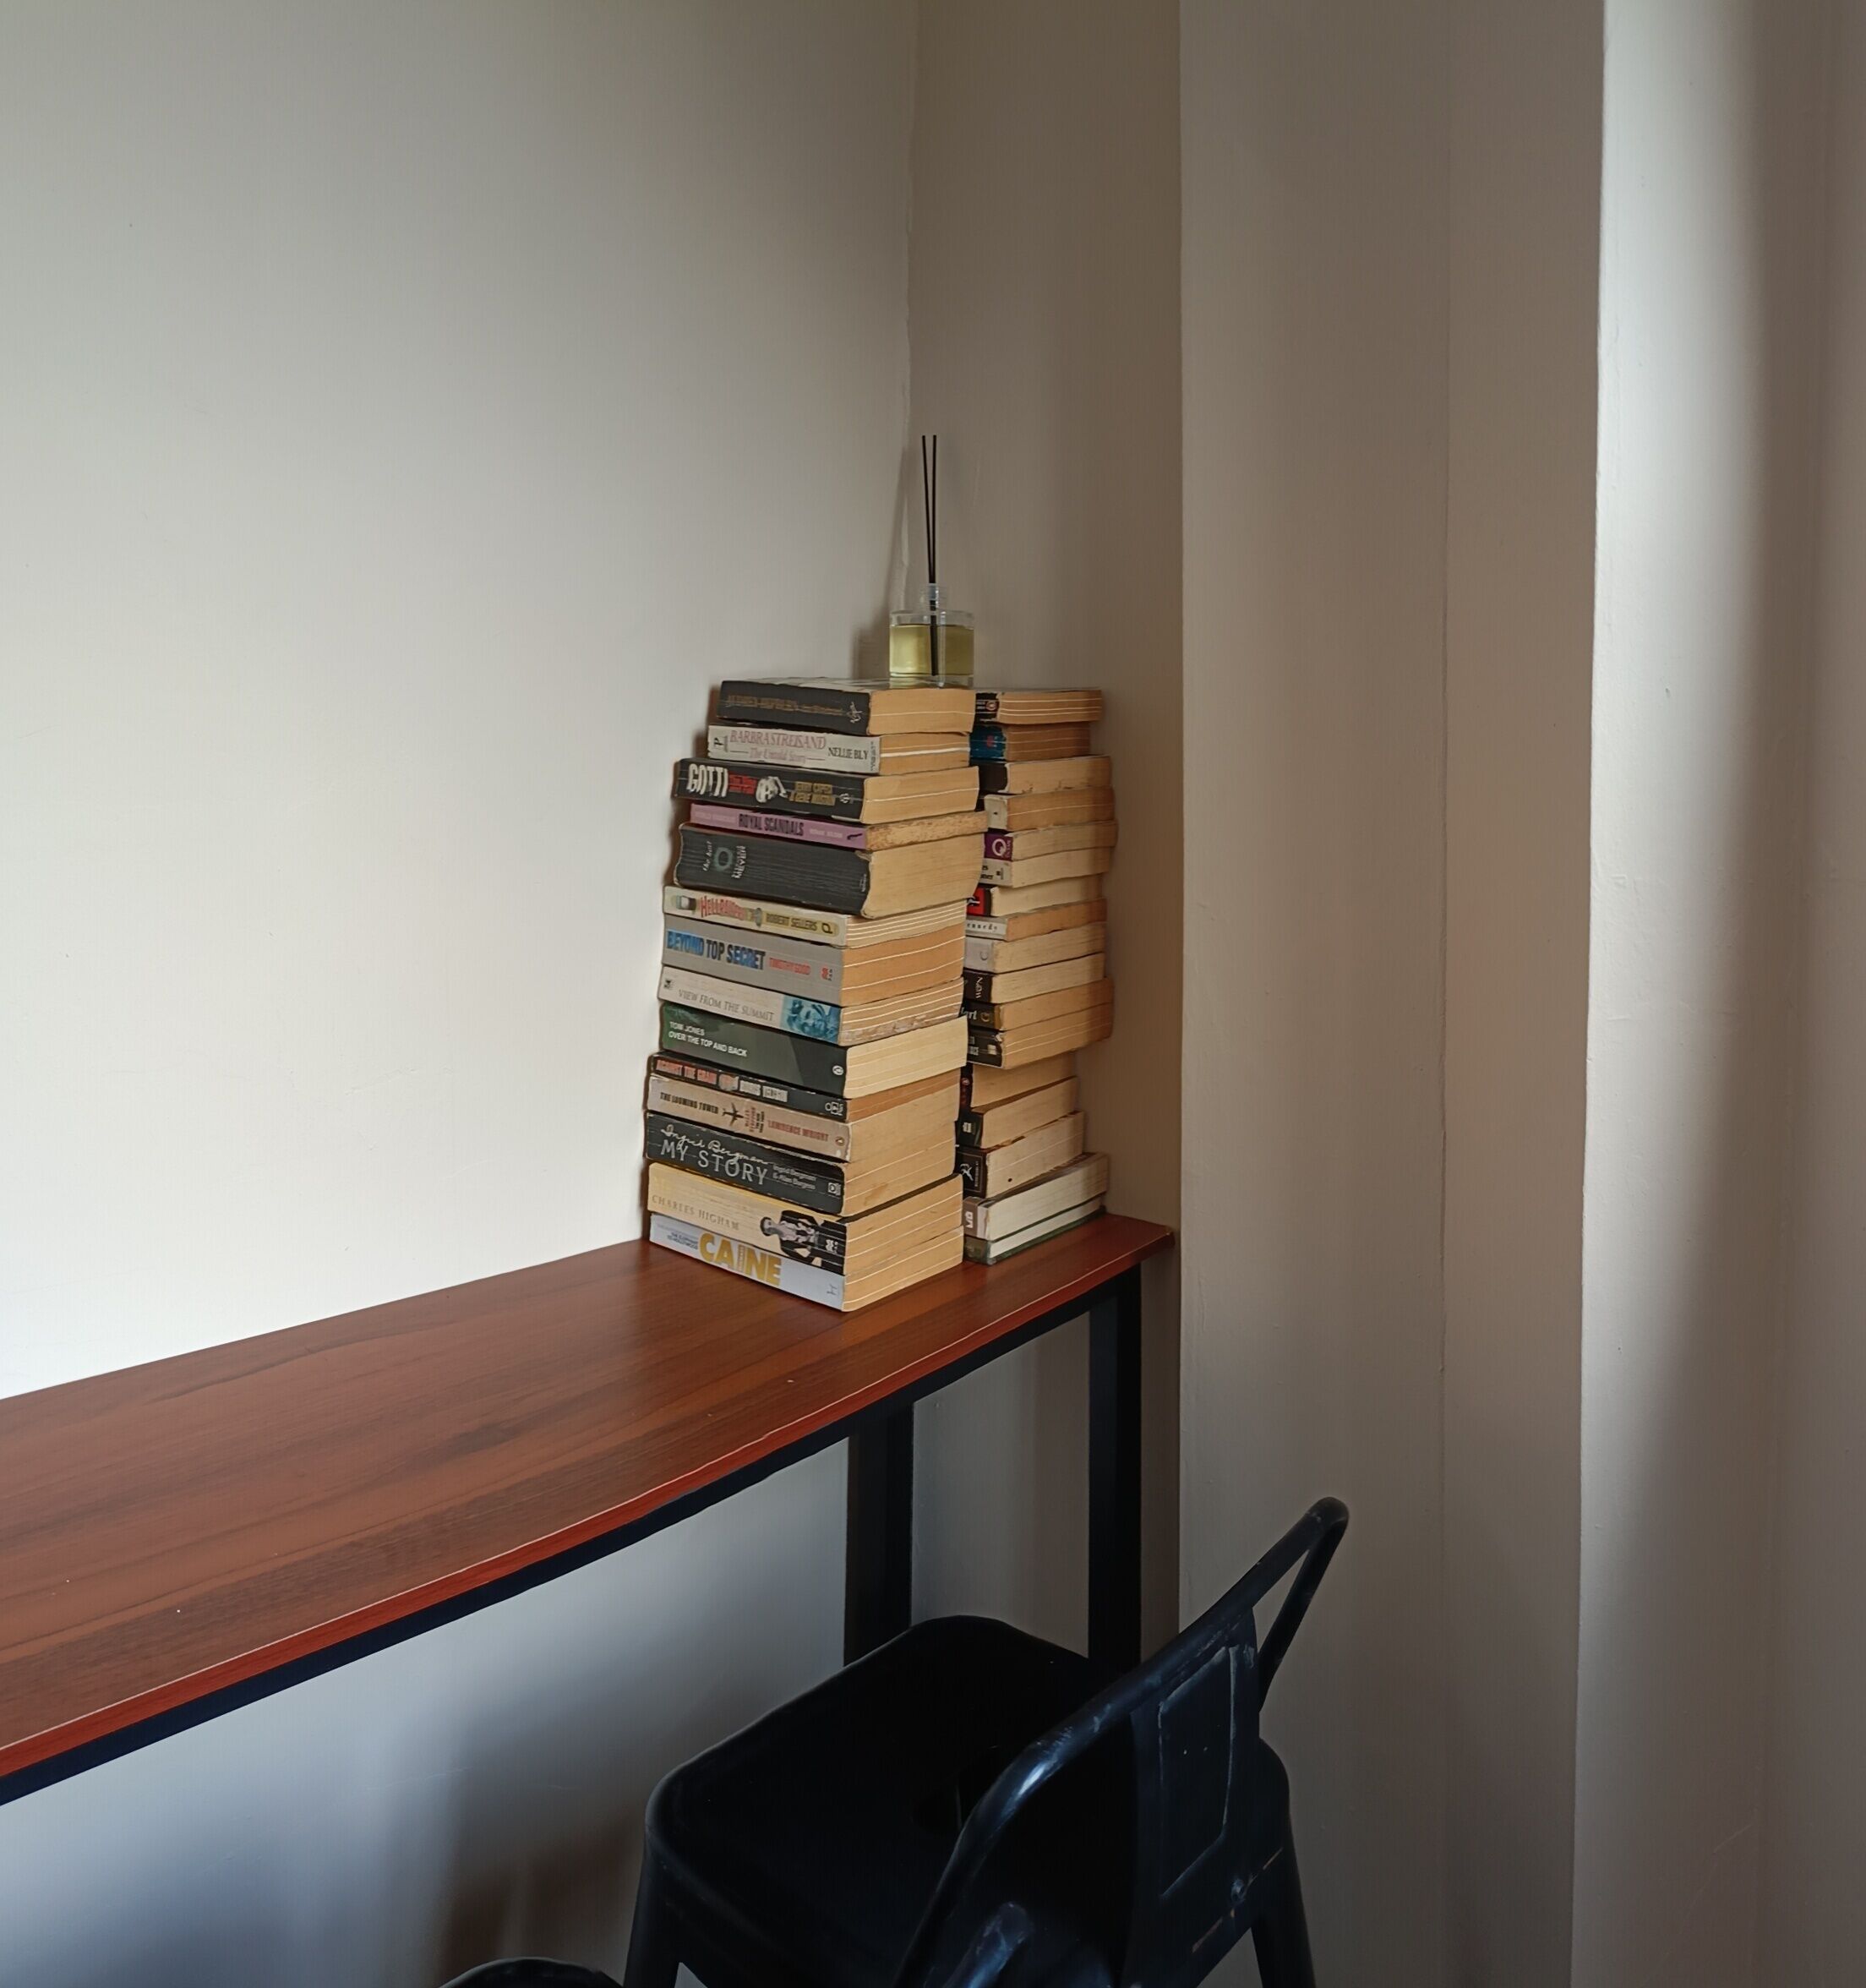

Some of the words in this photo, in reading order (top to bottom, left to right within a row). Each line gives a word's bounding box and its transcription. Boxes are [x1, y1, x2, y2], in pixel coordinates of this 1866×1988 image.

[828, 746, 852, 759] NELLIE
[854, 749, 869, 761] BLY
[687, 764, 728, 798] GOTTI
[739, 813, 761, 830] ROYAL
[764, 816, 805, 836] SCANDALS
[791, 916, 818, 931] SELLERS
[666, 931, 705, 956] BEYOND
[707, 939, 725, 961] TOP
[727, 944, 766, 970] SECRET
[679, 989, 698, 1002] VIEW
[699, 994, 721, 1008] FROM
[723, 1000, 739, 1013] THE
[742, 1004, 775, 1022] SUMMIT
[668, 1030, 686, 1041] OVER
[687, 1034, 701, 1045] THE
[701, 1037, 713, 1048] TOP
[712, 1041, 728, 1052] AND
[728, 1045, 748, 1057] BACK
[669, 1021, 684, 1032] TOM
[685, 1024, 706, 1036] JONES
[660, 1091, 671, 1101] THE
[671, 1095, 698, 1109] LOOMING
[699, 1101, 719, 1115] TOWER
[660, 1139, 689, 1161] MY
[698, 1150, 768, 1185] STORY
[652, 1193, 696, 1215] CHARLES
[698, 1209, 740, 1231] HIGHAM
[698, 1232, 783, 1286] CAINE
